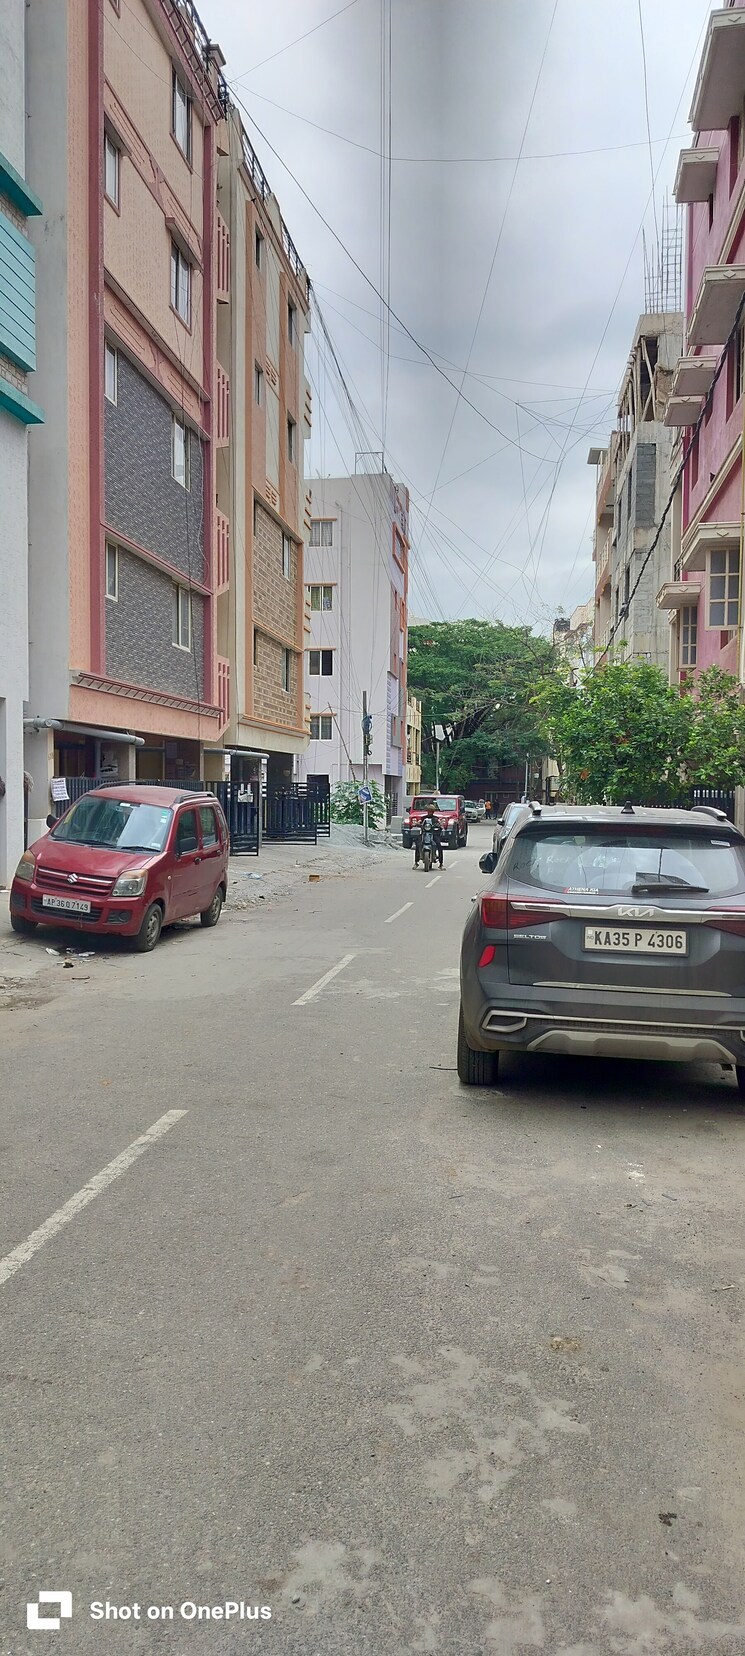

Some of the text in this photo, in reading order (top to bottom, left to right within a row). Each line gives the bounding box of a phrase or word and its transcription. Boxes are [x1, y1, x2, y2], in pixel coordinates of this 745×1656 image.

[595, 931, 683, 949] KA35 P 4306
